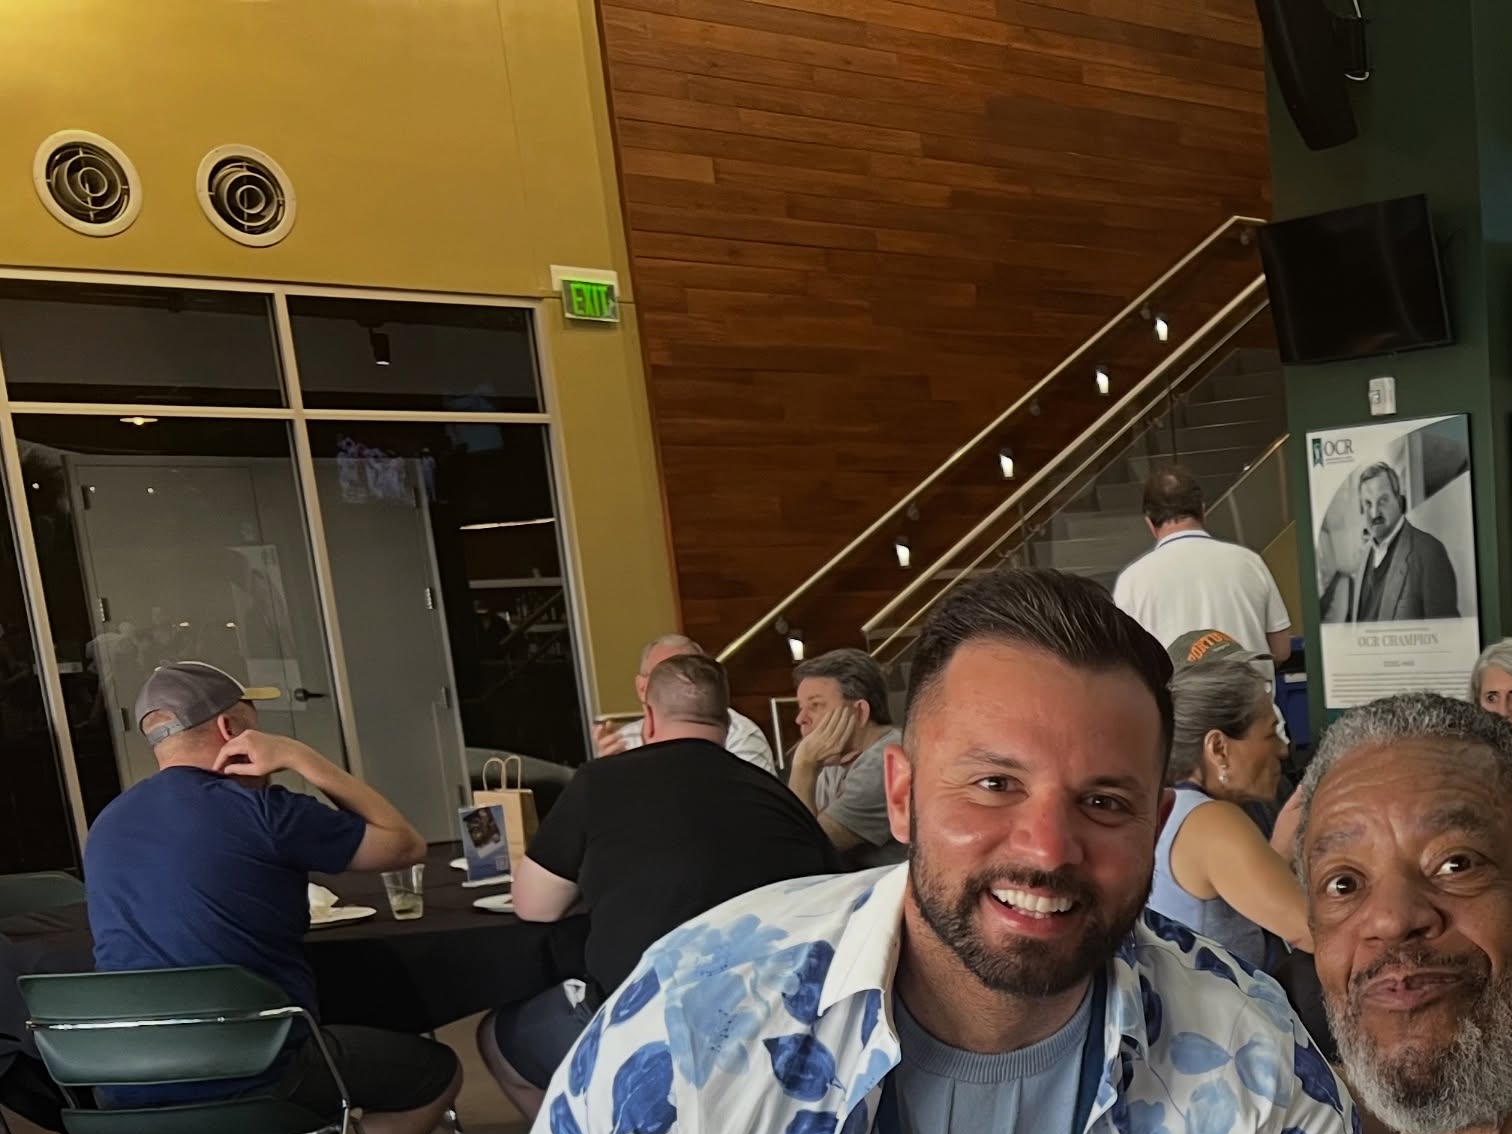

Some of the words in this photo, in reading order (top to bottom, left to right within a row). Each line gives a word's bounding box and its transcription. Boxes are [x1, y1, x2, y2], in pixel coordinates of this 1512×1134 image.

[570, 283, 608, 317] EXIT
[1323, 439, 1354, 457] OCR
[1358, 635, 1380, 648] OCR
[1382, 633, 1439, 647] CHAMPION
